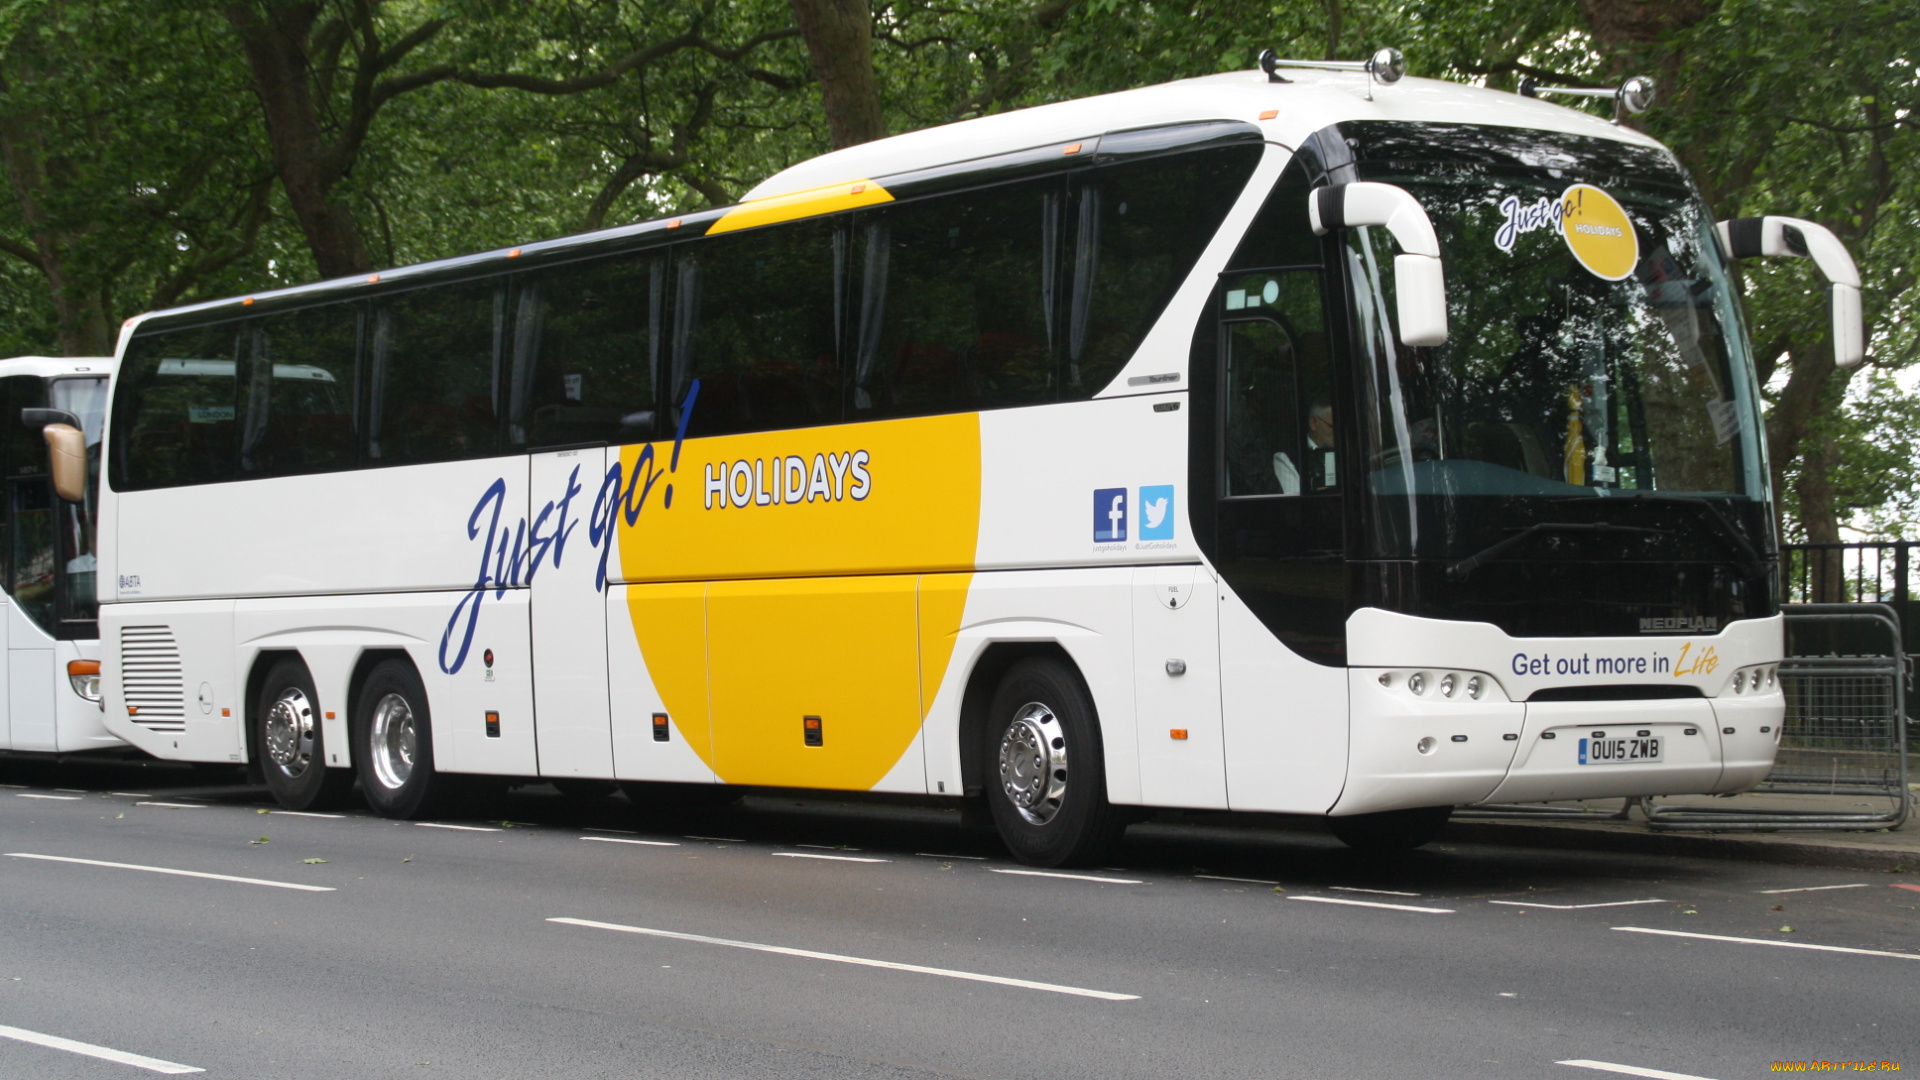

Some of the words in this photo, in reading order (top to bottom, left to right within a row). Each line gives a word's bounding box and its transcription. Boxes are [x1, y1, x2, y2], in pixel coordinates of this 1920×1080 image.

[1497, 198, 1549, 248] Just
[1552, 188, 1583, 230] go!
[1574, 223, 1624, 238] HOLIDAYS
[704, 449, 872, 510] HOLIDAYS
[438, 463, 581, 675] Just
[588, 378, 700, 593] go!
[1639, 616, 1717, 632] NEOPLAN
[1512, 653, 1550, 675] Get
[1556, 653, 1590, 675] out
[1595, 657, 1647, 675] more
[1653, 652, 1669, 673] in
[1674, 642, 1720, 677] Life
[1592, 740, 1625, 760] OU15
[1630, 739, 1659, 758] ZWB
